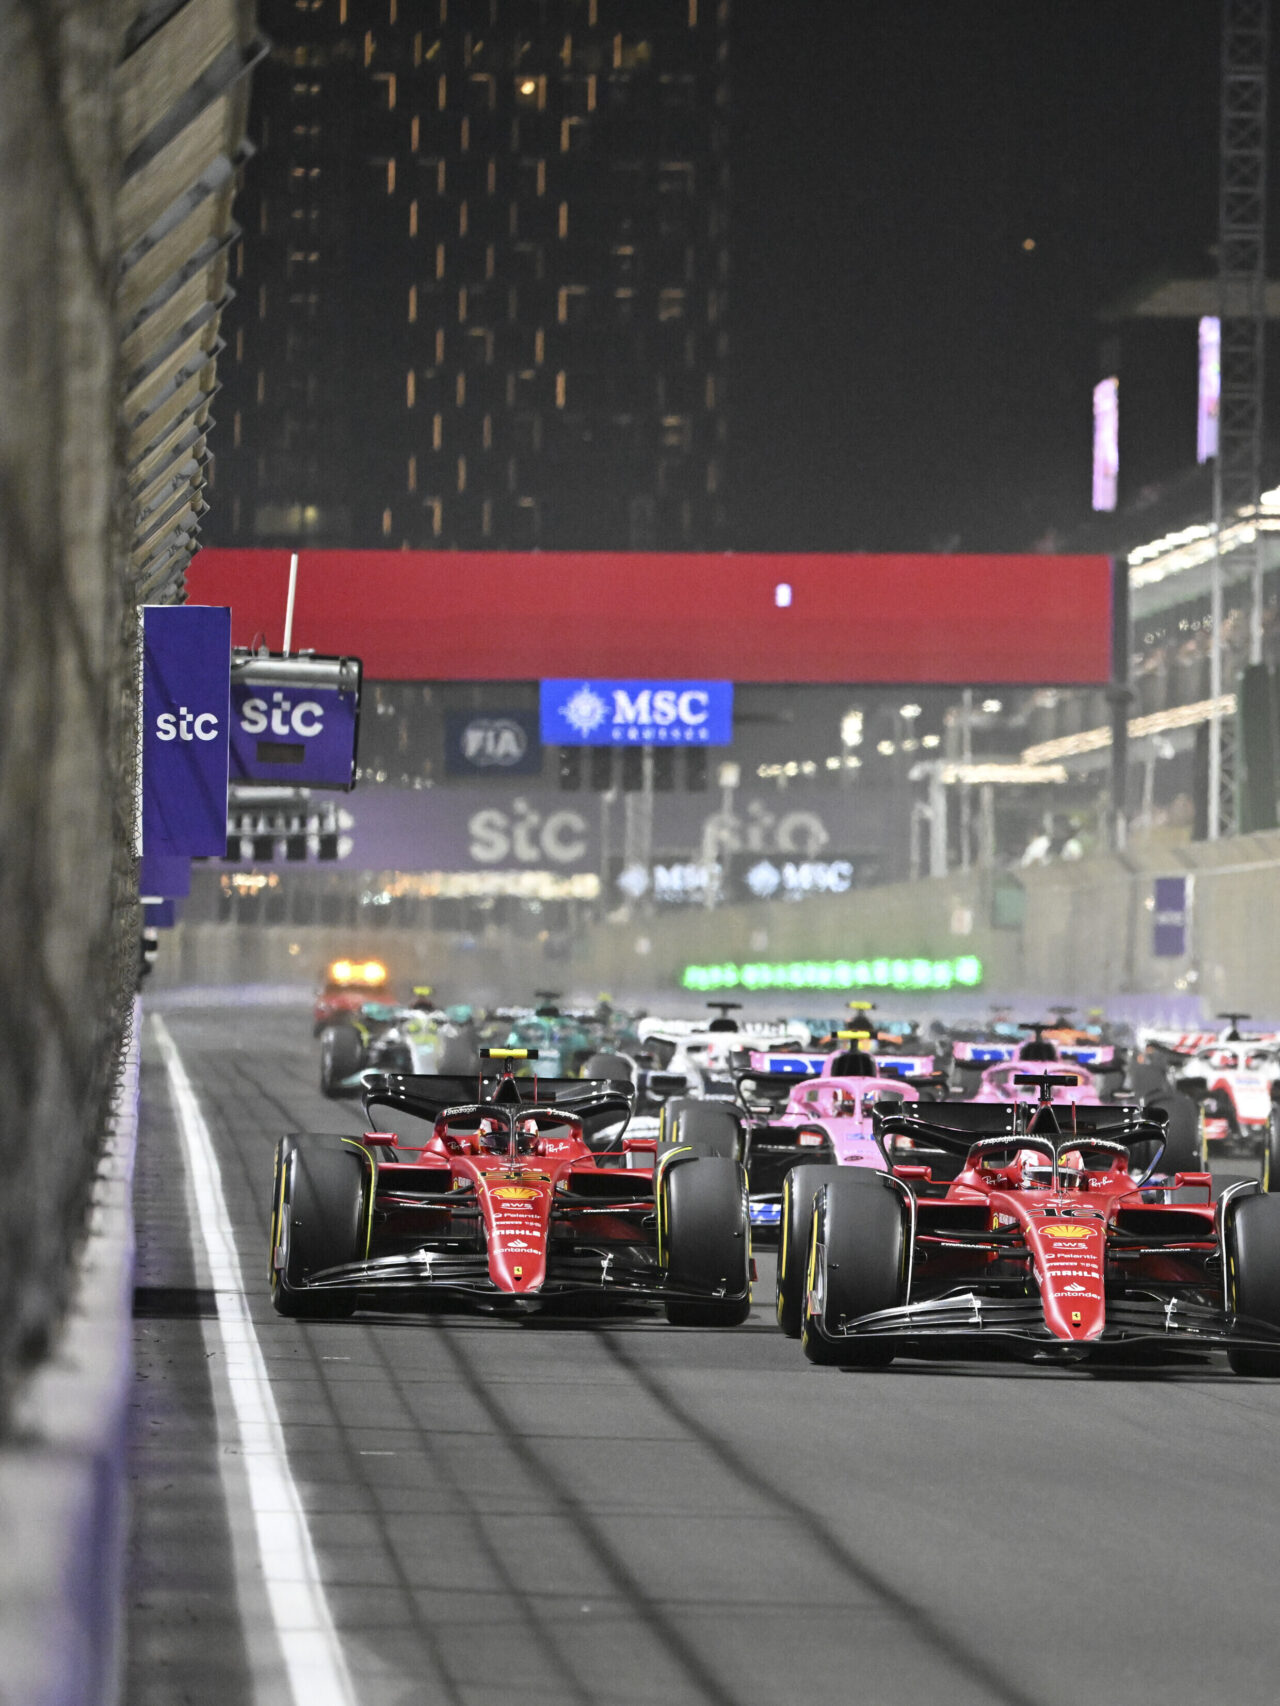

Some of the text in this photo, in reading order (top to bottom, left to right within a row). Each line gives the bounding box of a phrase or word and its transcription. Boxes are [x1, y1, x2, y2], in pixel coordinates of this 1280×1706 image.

[240, 691, 324, 737] stc
[612, 690, 709, 725] MSC
[156, 707, 218, 741] stc
[468, 796, 586, 863] stc
[501, 1202, 534, 1210] aws
[492, 1229, 541, 1238] MAHLE
[1053, 1241, 1088, 1250] aws
[1046, 1270, 1100, 1279] MAHLE
